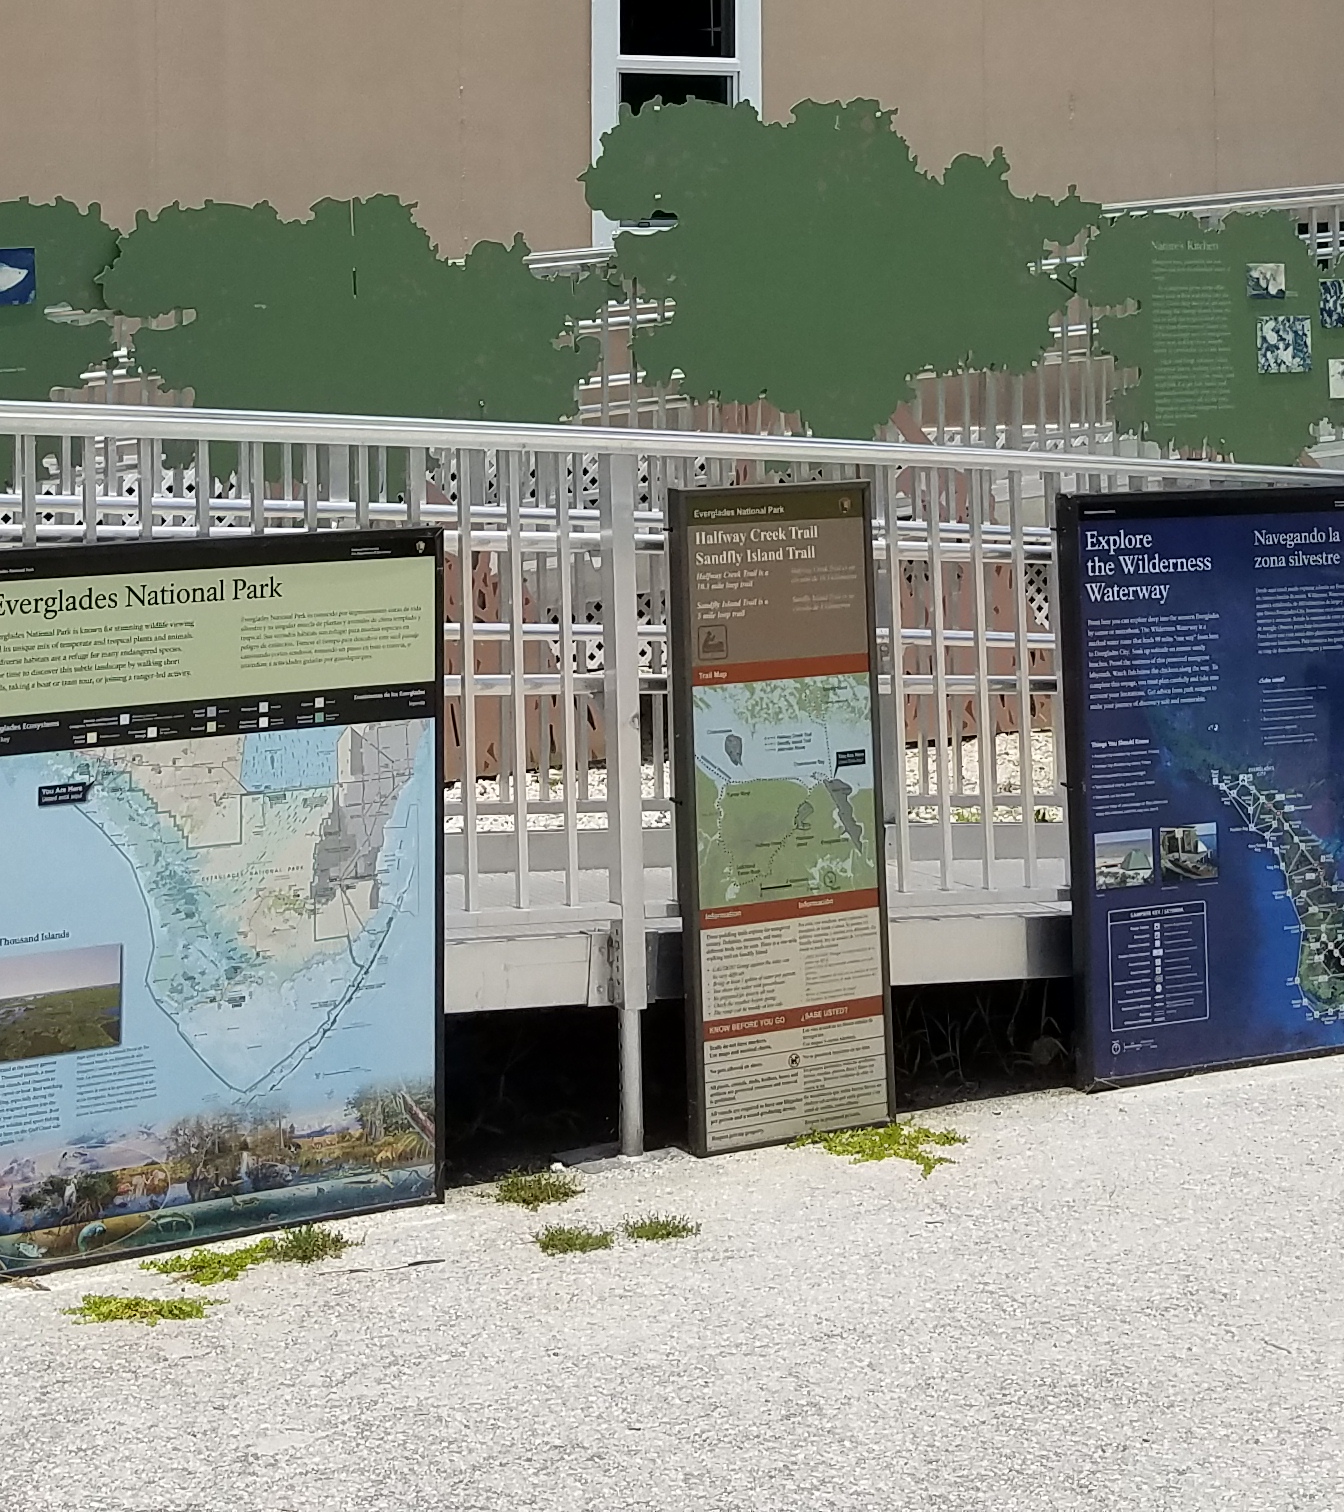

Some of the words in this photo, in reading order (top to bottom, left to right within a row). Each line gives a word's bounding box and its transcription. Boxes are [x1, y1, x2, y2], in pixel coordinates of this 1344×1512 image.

[694, 508, 735, 519] Everglades
[736, 506, 766, 516] National
[768, 505, 784, 514] Park
[695, 530, 747, 546] Halfway
[750, 527, 787, 542] Creek
[788, 525, 818, 540] Trail
[1085, 529, 1153, 555] Explore
[1253, 527, 1326, 548] Navegando
[1328, 527, 1341, 543] la
[695, 550, 743, 566] Sandfly
[746, 547, 784, 563] Island
[786, 545, 816, 560] Trail
[1254, 555, 1286, 568] zona
[1288, 550, 1341, 567] silvestre
[1086, 557, 1115, 577] the
[1118, 553, 1212, 575] Wilderness
[125, 579, 225, 608] National
[232, 576, 283, 600] Park
[1085, 582, 1170, 605] Waterway
[56, 627, 71, 636] Park
[72, 627, 78, 635] is
[51, 641, 59, 649] of
[93, 637, 106, 646] and
[153, 633, 166, 641] and
[90, 651, 100, 659] for
[30, 668, 58, 676] discover
[59, 666, 72, 674] this
[127, 661, 136, 669] by
[137, 660, 163, 668] walking
[163, 658, 180, 666] short
[699, 671, 712, 680] Trail
[713, 670, 727, 679] Map
[8, 683, 31, 691] taking
[67, 785, 83, 793] Here
[41, 930, 70, 941] Islands
[823, 1007, 849, 1018] USTED?
[709, 1025, 730, 1035] KNOW
[731, 1021, 758, 1031] BEFORE
[759, 1019, 773, 1027] YOU
[774, 1017, 785, 1025] GO
